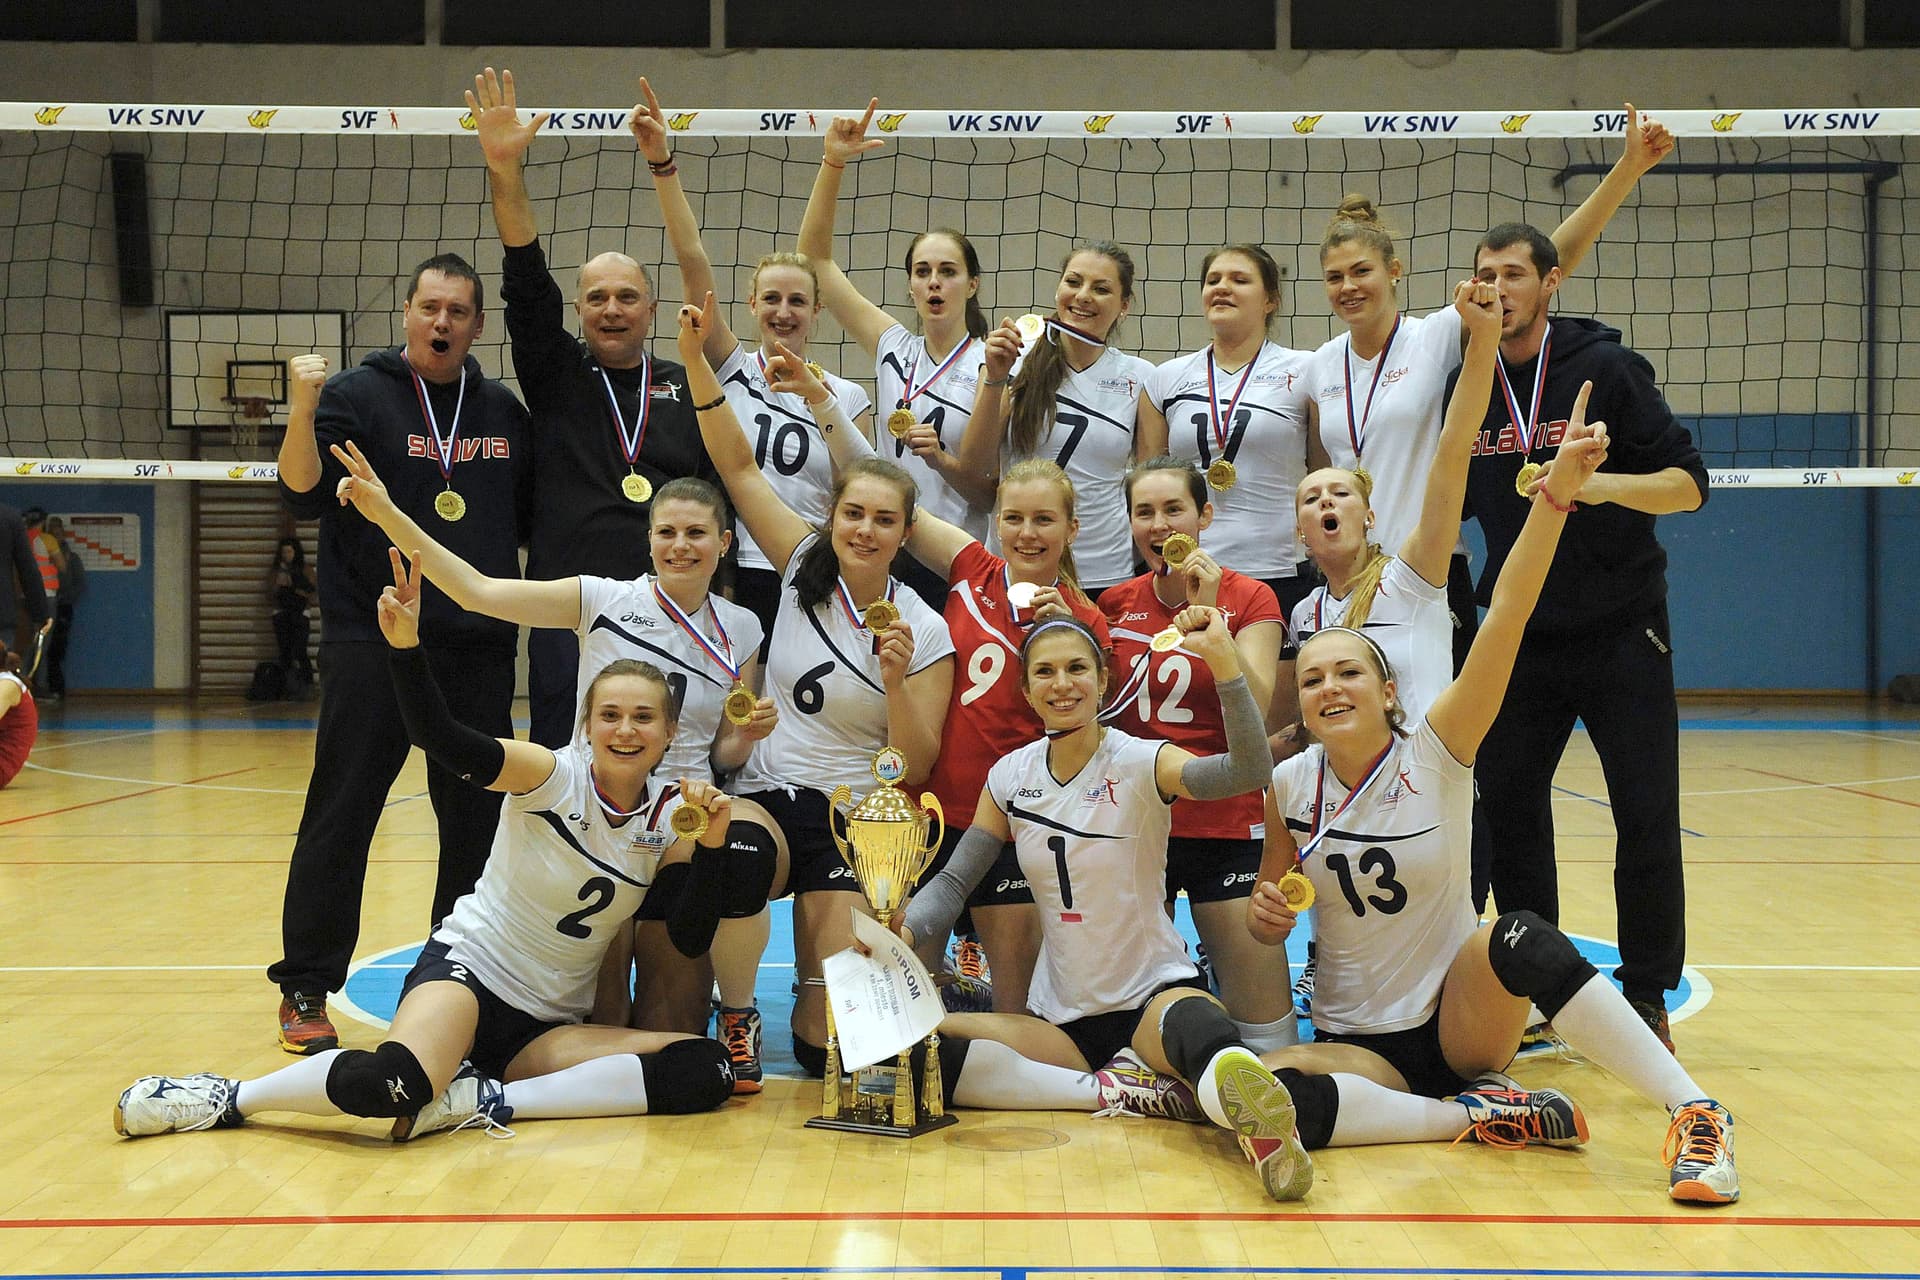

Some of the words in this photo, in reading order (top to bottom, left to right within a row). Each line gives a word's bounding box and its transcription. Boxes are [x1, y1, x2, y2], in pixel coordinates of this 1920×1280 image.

[108, 108, 144, 126] VK
[149, 109, 205, 126] SNV
[340, 110, 378, 129] SVF
[571, 113, 626, 130] SNV
[759, 112, 797, 131] SVF
[948, 114, 983, 132] VK
[987, 114, 1043, 132] SNV
[1175, 115, 1213, 134] SVF
[1364, 115, 1399, 133] VK
[1403, 115, 1459, 133] SNV
[1592, 114, 1629, 133] SVF
[1784, 113, 1819, 130] VK
[1823, 113, 1880, 130] SNV
[754, 413, 810, 476] 10
[1055, 412, 1089, 470] 7
[1190, 409, 1252, 470] 17
[40, 464, 56, 474] VK
[57, 464, 81, 474] SNV
[134, 464, 160, 477] SVF
[253, 468, 268, 478] VK
[1710, 475, 1725, 484] VK
[1727, 475, 1750, 484] SNV
[1803, 472, 1828, 485] SVF
[632, 615, 656, 628] asics
[1127, 611, 1149, 621] asics
[961, 642, 1006, 706] 9
[793, 661, 836, 715] 6
[1130, 654, 1194, 723] 12
[879, 763, 893, 771] SVF
[1048, 836, 1073, 910] 1
[1237, 872, 1259, 883] asic
[1010, 879, 1031, 889] asic
[1326, 847, 1408, 918] 13
[556, 876, 616, 939] 2
[890, 946, 921, 1000] DIPLOM
